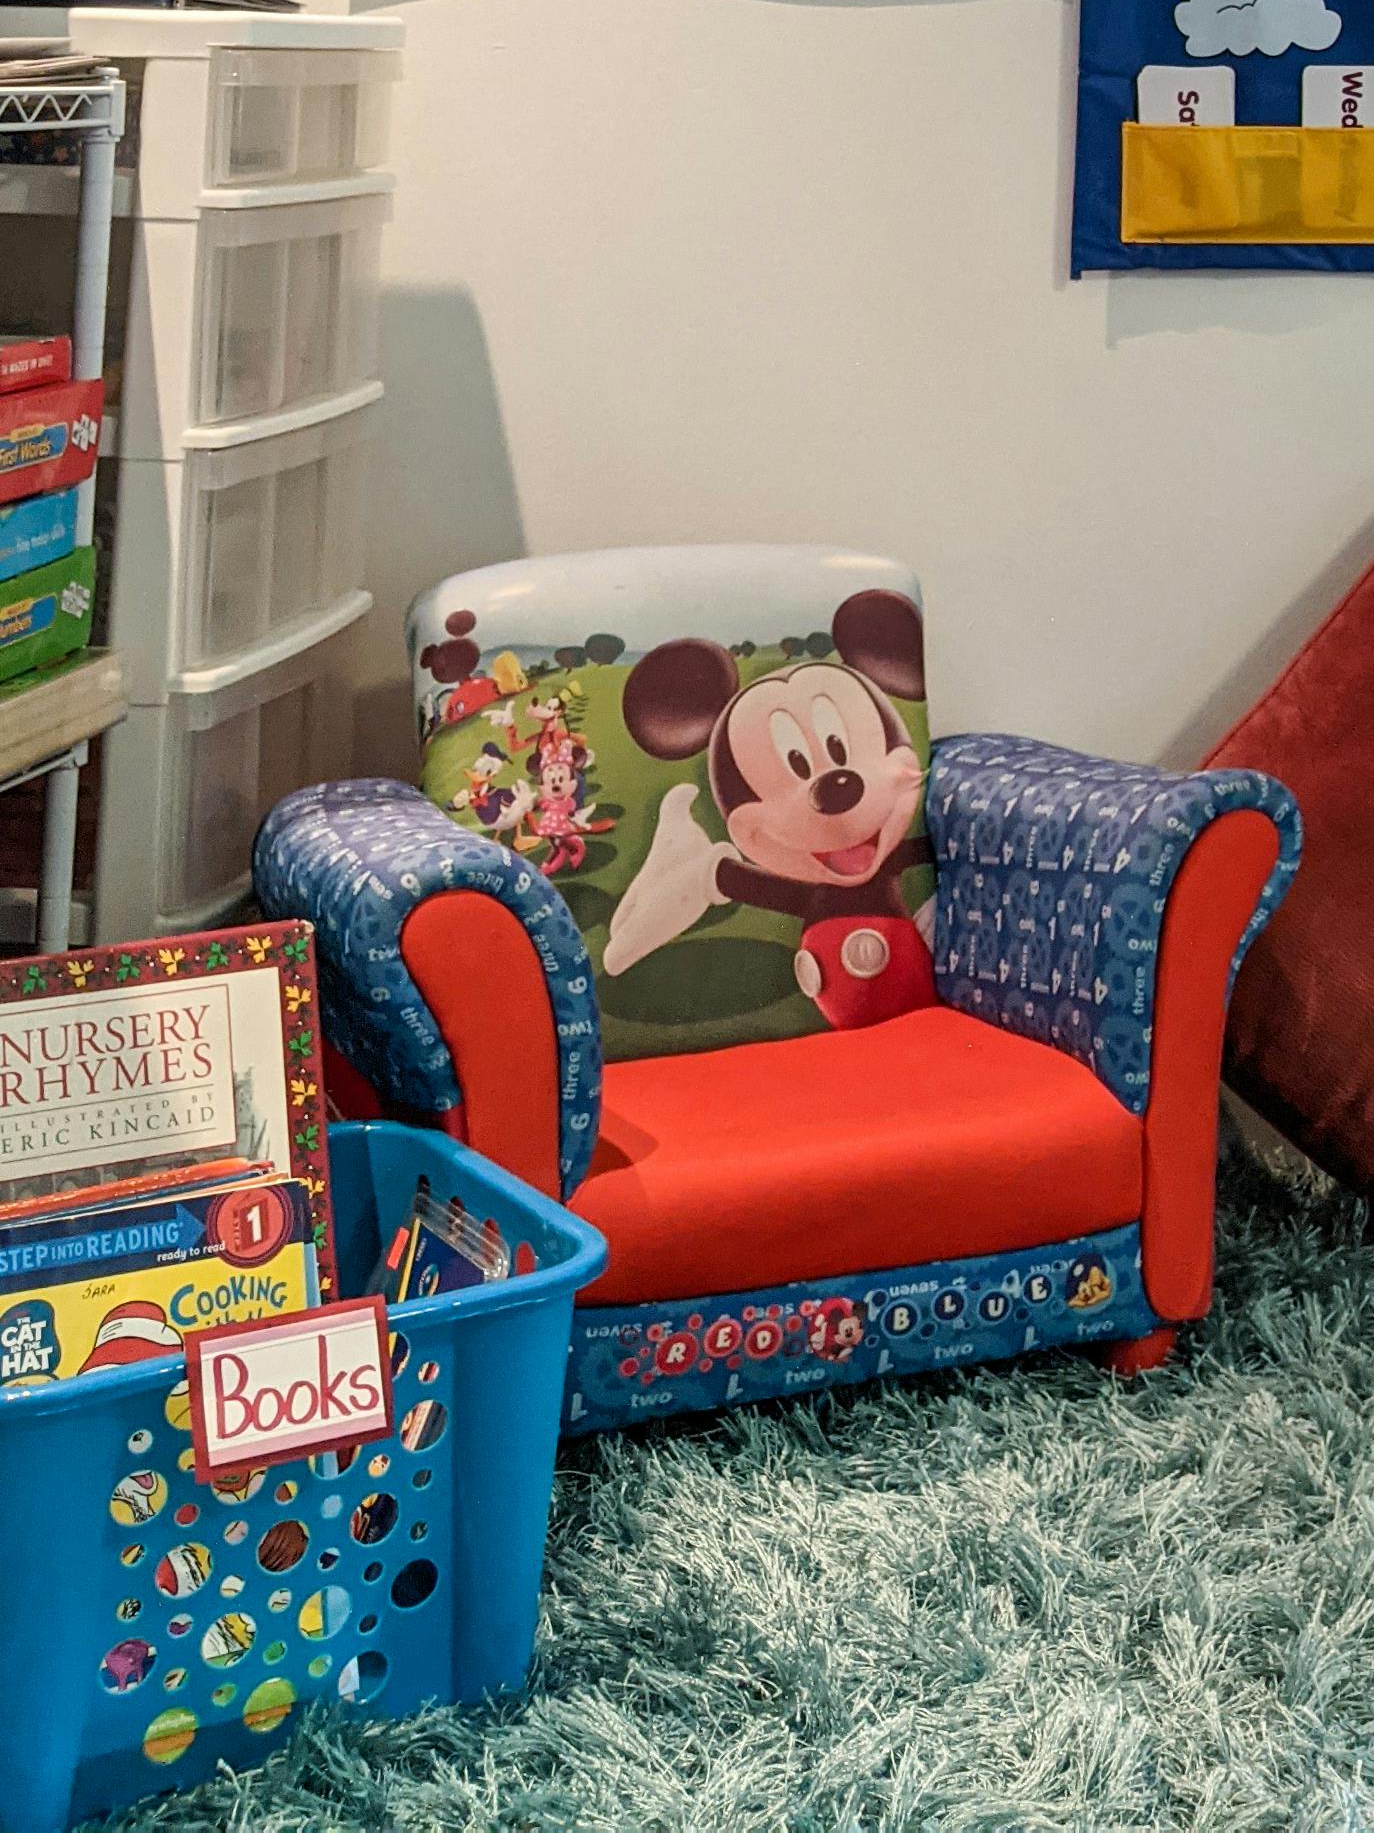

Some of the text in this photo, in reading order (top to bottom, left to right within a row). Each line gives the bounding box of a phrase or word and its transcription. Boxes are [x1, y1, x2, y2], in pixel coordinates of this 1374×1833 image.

[1177, 90, 1200, 126] Sa
[0, 1004, 210, 1068] NURSERY
[0, 1042, 212, 1108] RHYMES
[192, 1092, 214, 1103] BY
[1, 1106, 215, 1154] ERIC KINCAID
[247, 1205, 262, 1243] 1
[0, 1224, 180, 1274] STEP INTO READING
[156, 1240, 226, 1263] ready to read
[170, 1274, 288, 1326] COOKING
[1, 1320, 47, 1347] CAT
[1, 1346, 53, 1378] HAT
[212, 1333, 380, 1440] Books
